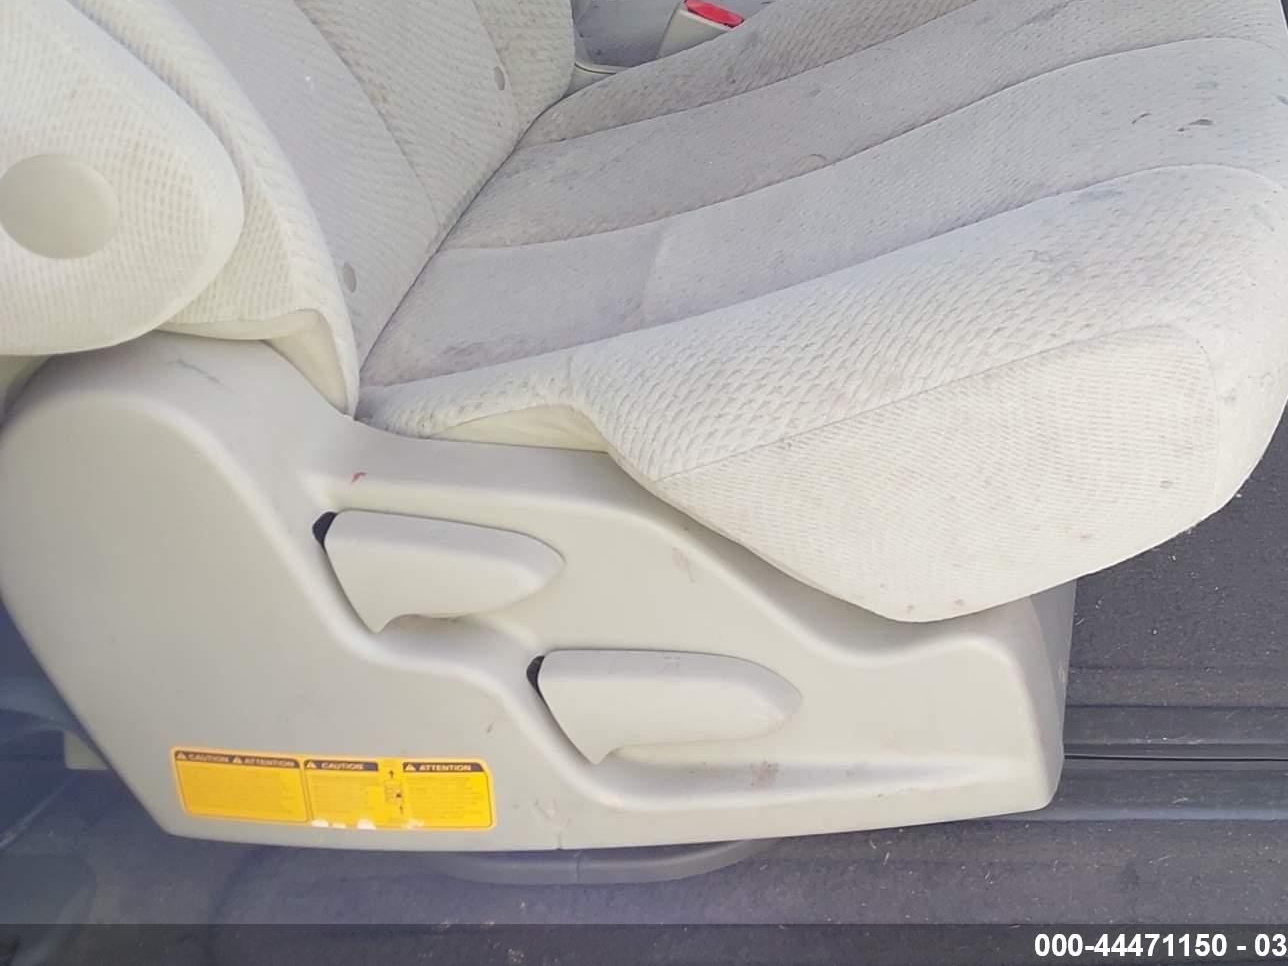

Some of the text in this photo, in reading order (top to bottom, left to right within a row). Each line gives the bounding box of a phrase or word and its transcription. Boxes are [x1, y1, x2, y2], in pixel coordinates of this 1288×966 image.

[188, 753, 296, 768] CAUTION ATTENTION
[321, 761, 364, 771] CAUTION
[419, 764, 472, 772] ATTENTION
